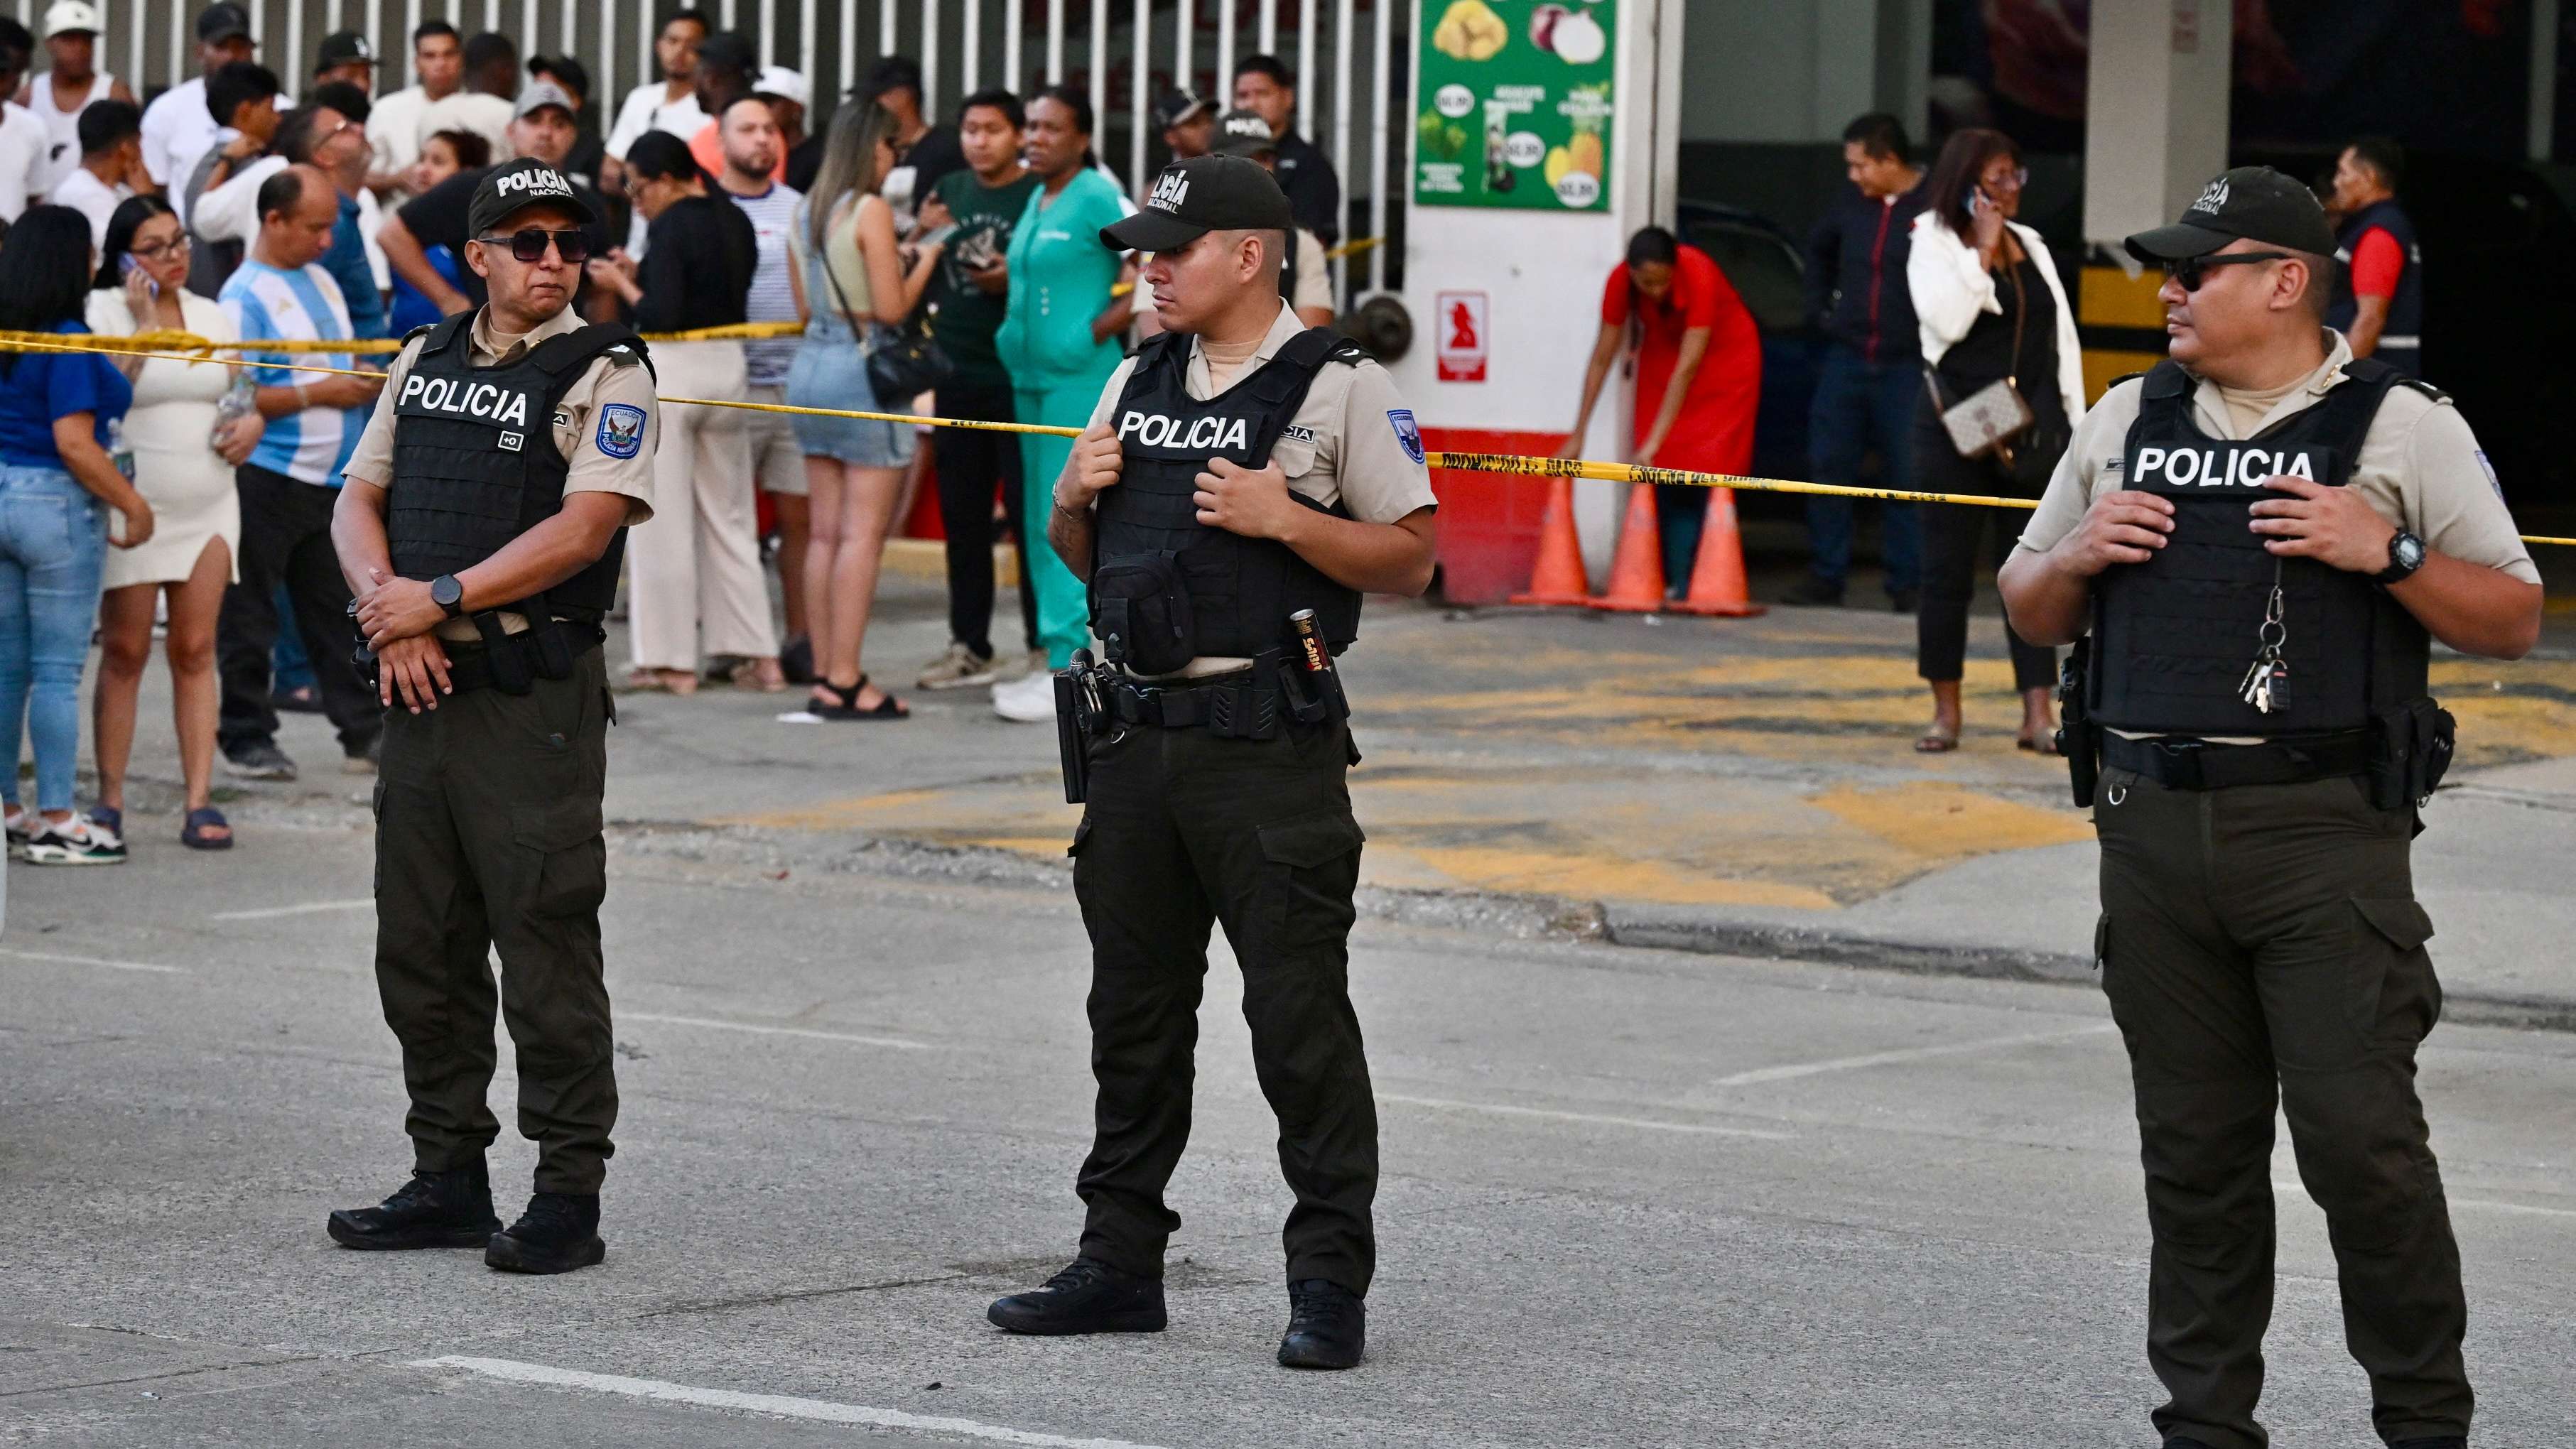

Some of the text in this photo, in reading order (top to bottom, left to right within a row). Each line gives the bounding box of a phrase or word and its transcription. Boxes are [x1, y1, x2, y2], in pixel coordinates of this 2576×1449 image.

[399, 375, 526, 427] POLICIA
[610, 410, 639, 419] ECUADOR
[1117, 411, 1246, 450] POLICIA
[2133, 447, 2315, 487] POLICIA
